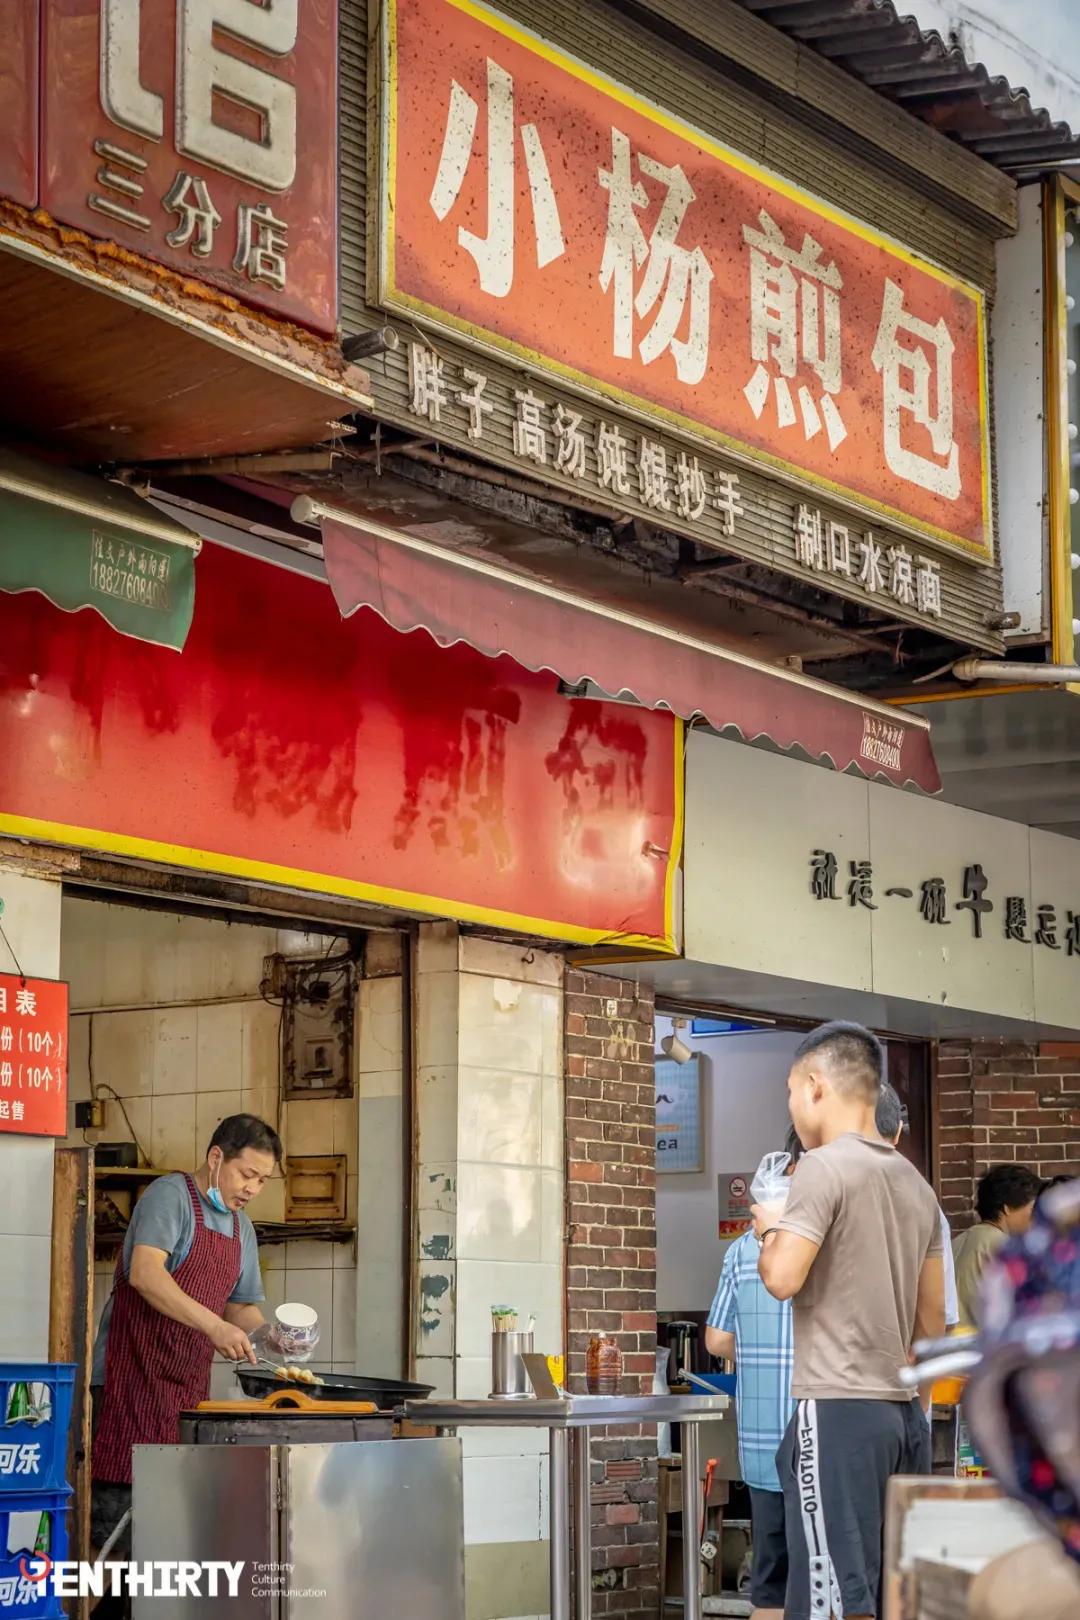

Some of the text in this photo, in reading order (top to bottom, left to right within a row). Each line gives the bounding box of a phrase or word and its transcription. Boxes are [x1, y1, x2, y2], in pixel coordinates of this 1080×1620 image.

[88, 139, 289, 292] 三分店
[429, 56, 962, 500] 小杨煎包
[793, 503, 942, 618] 制口水凉面
